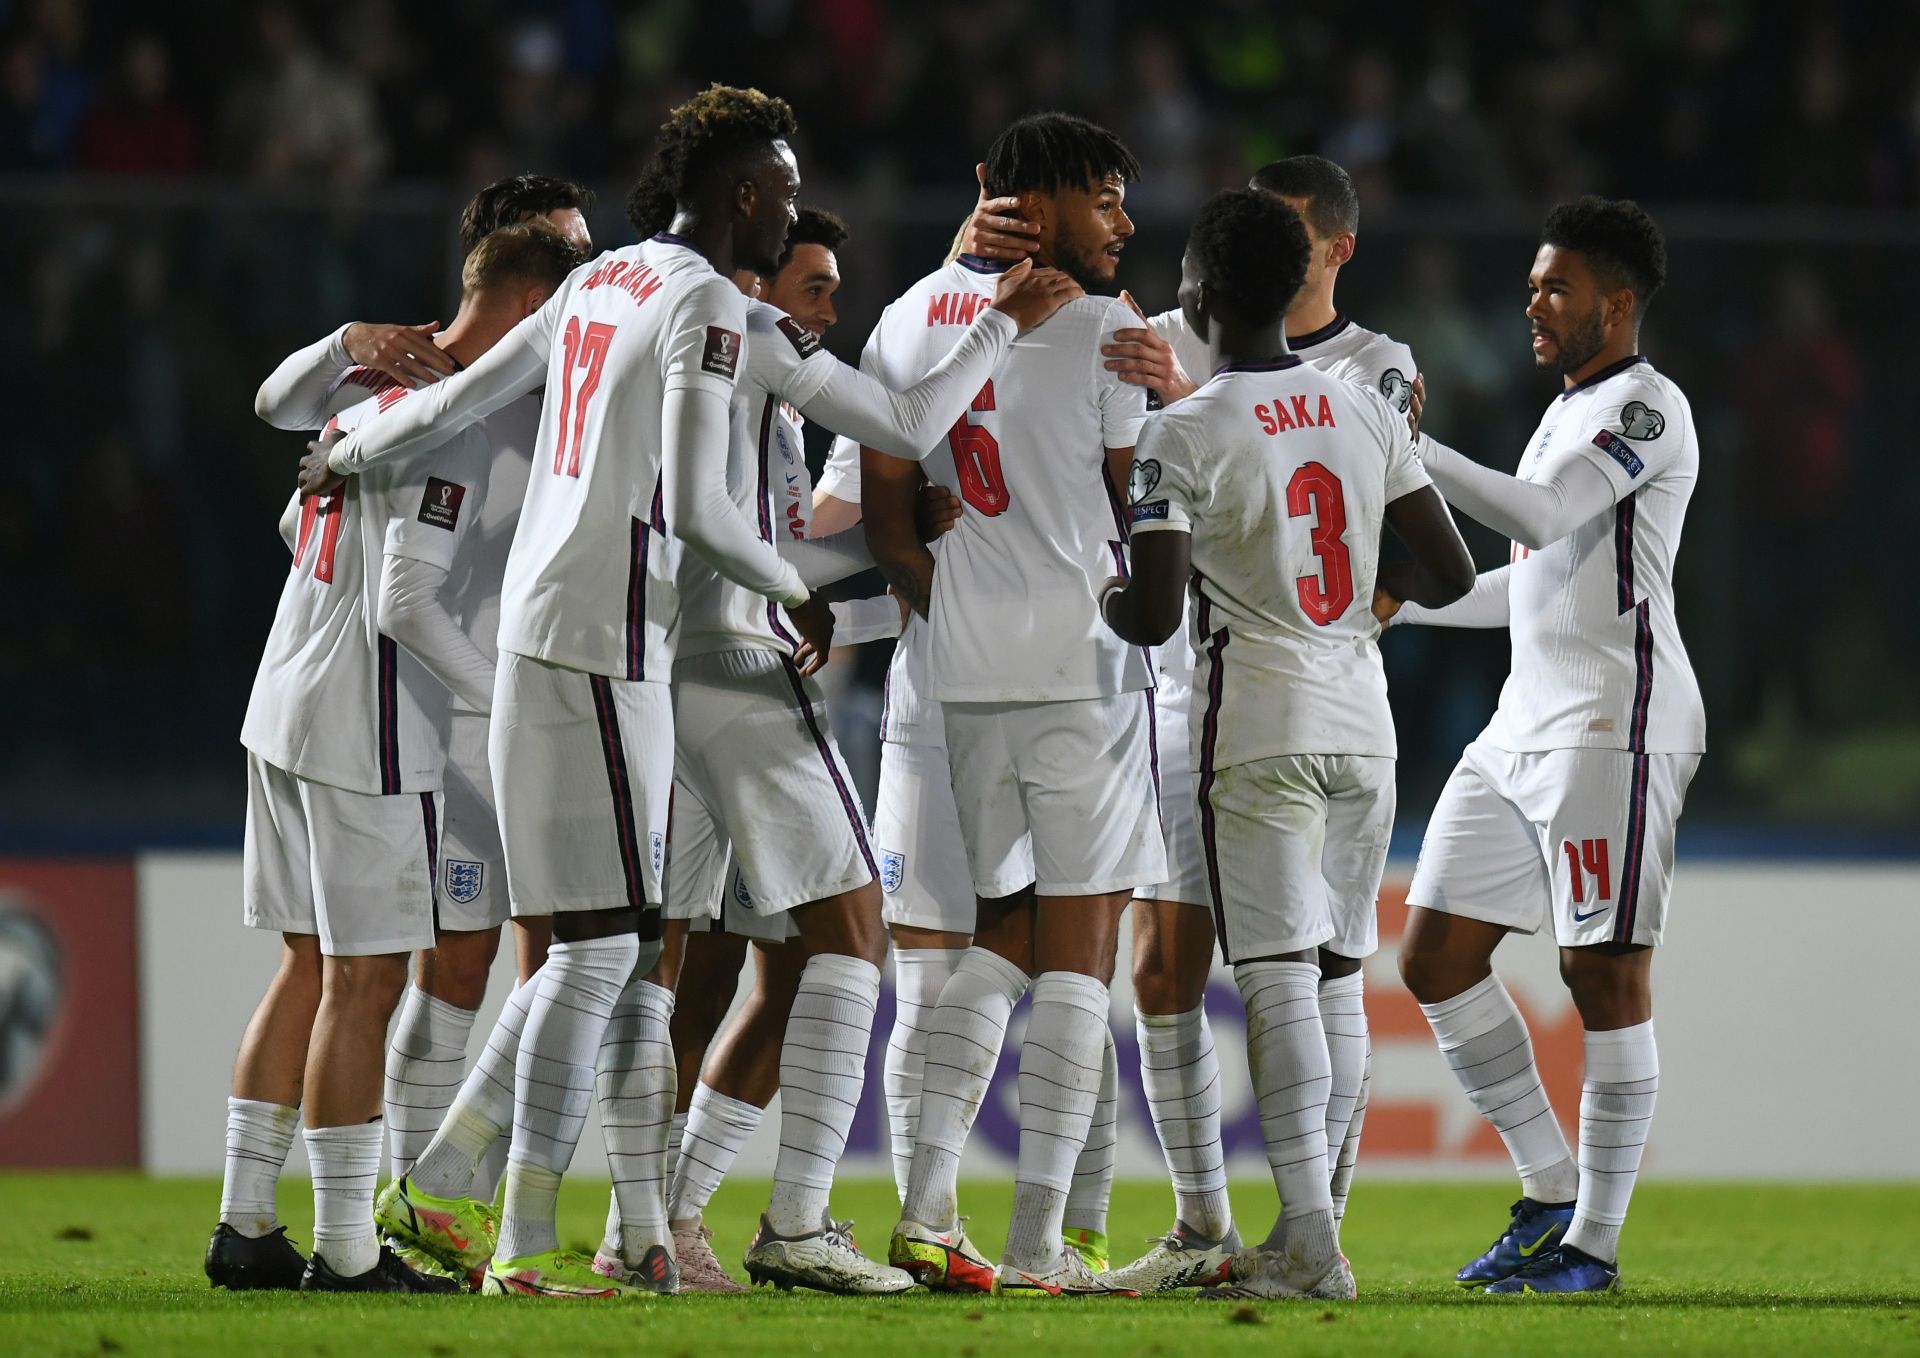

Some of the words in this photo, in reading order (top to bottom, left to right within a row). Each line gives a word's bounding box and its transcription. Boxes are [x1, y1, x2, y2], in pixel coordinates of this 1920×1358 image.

[579, 260, 663, 307] ABRAHAM
[553, 315, 618, 478] 17
[1254, 394, 1335, 436] SAKA
[947, 377, 1010, 517] 6
[1608, 441, 1641, 474] RESPECT
[1286, 461, 1354, 626] 3
[1564, 839, 1611, 902] 14
